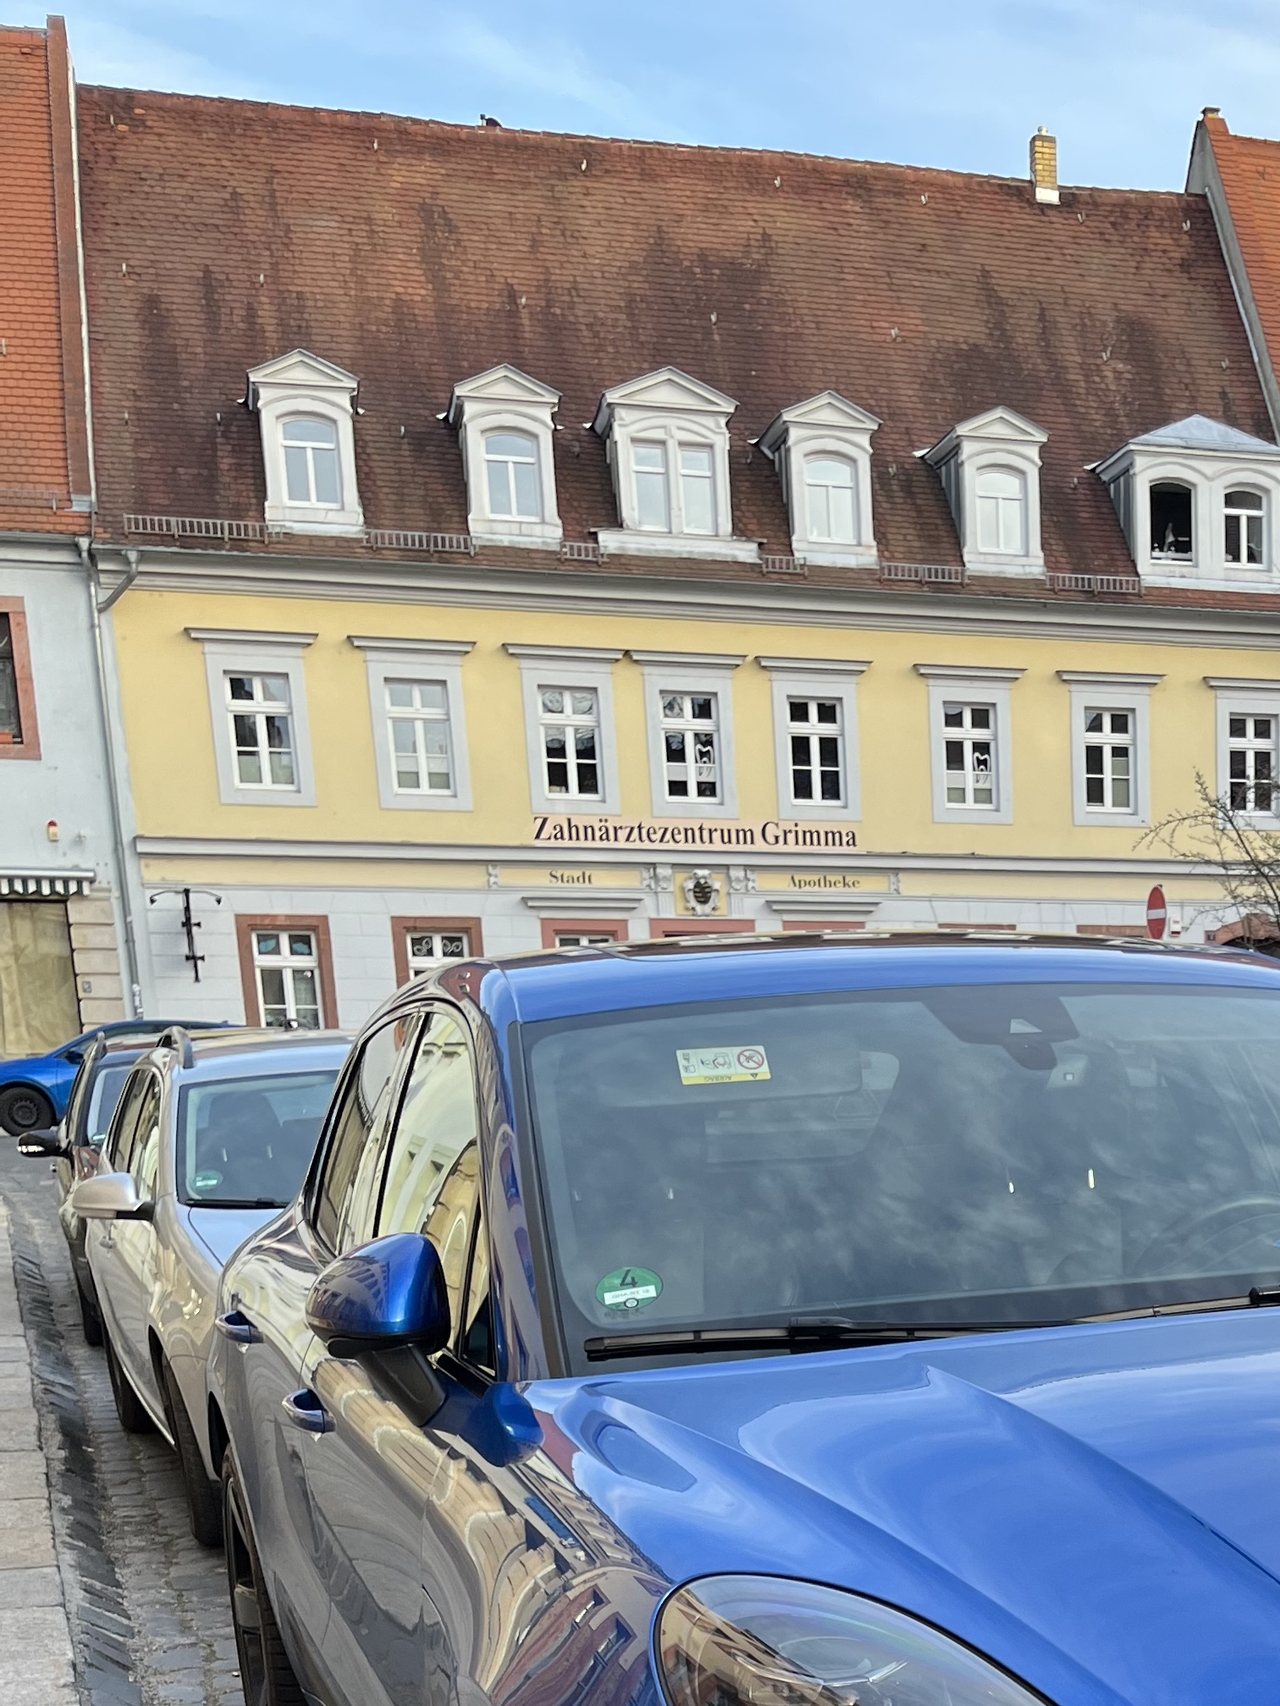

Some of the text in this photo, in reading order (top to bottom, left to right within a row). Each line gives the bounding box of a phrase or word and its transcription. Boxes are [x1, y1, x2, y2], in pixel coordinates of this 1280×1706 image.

[533, 816, 857, 848] Zahnärztezentrum Grimma
[549, 870, 861, 892] Stadt Apotheke
[620, 1269, 638, 1287] 4
